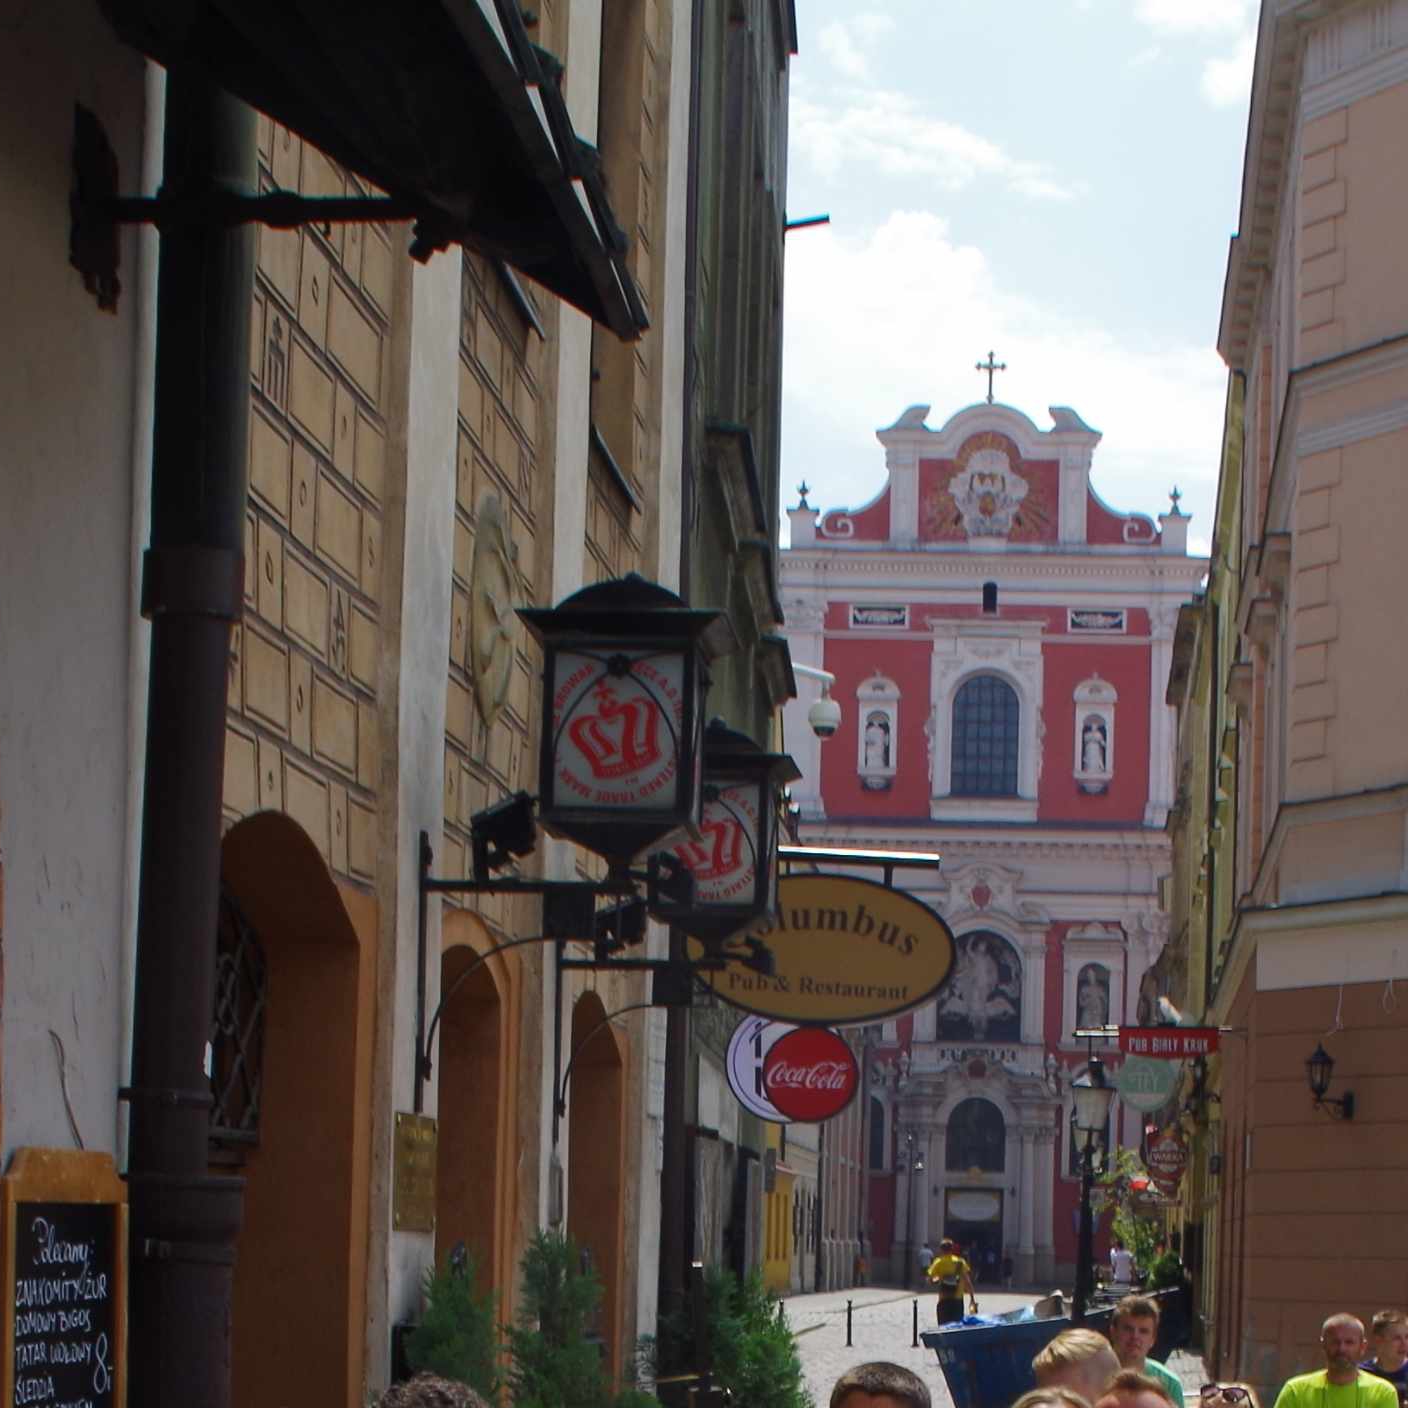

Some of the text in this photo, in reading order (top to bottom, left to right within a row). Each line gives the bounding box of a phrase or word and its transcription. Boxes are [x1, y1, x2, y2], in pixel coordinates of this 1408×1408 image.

[728, 971, 909, 1001] Pub & Restaurant
[766, 1061, 849, 1090] Coca-Cola
[58, 1309, 92, 1333] BIGOS
[16, 1342, 48, 1370] TATAR
